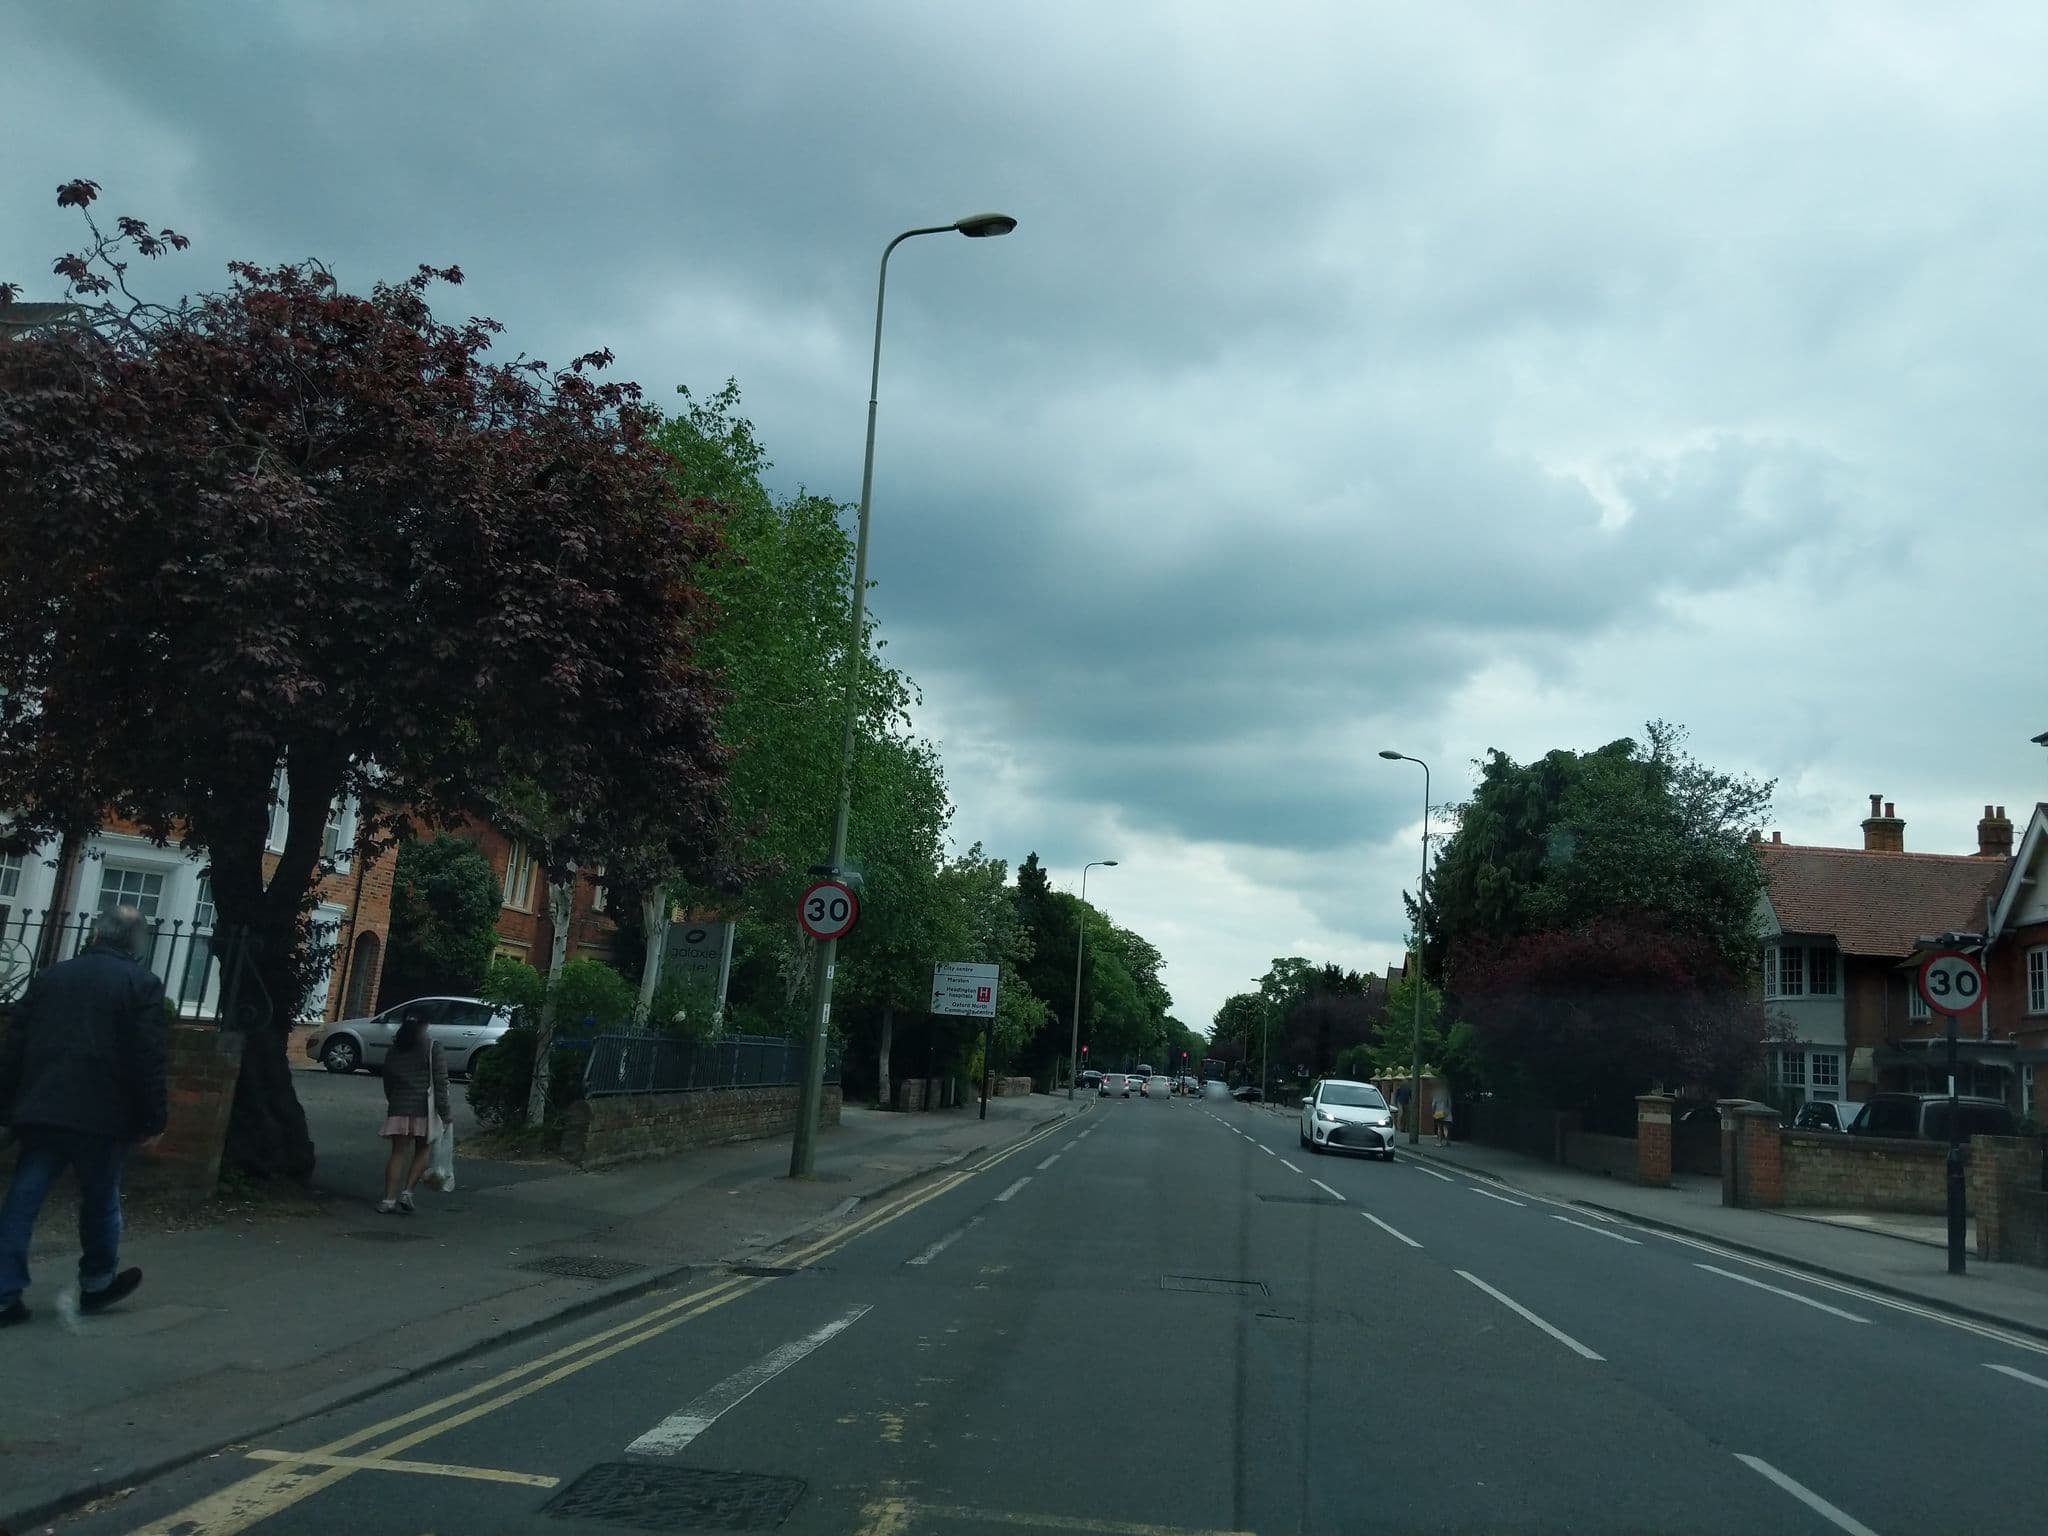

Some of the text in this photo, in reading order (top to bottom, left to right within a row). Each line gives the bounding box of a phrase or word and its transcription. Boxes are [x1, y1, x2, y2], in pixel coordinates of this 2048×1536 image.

[808, 897, 849, 922] 30
[671, 946, 717, 960] galaxie
[943, 964, 955, 972] City
[1930, 969, 1978, 997] 30
[946, 986, 977, 994] Headington
[979, 988, 988, 997] H
